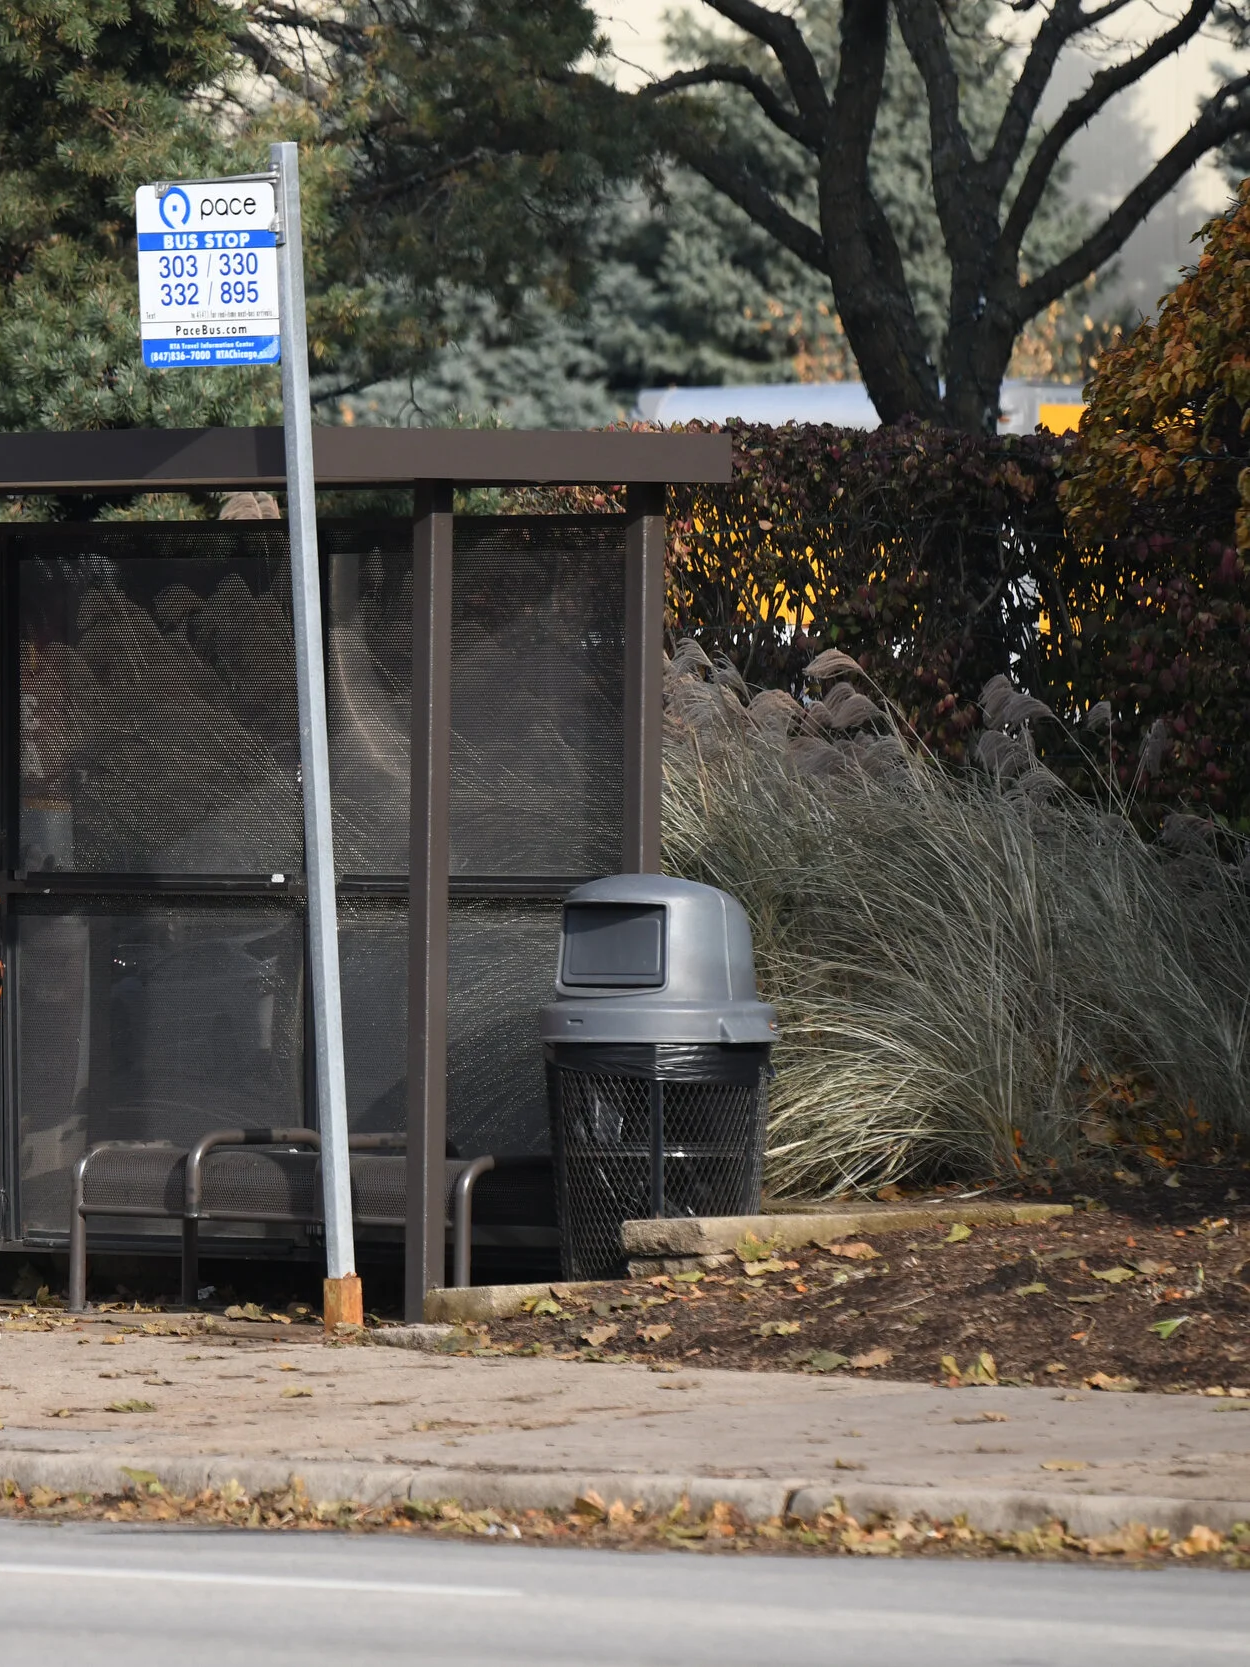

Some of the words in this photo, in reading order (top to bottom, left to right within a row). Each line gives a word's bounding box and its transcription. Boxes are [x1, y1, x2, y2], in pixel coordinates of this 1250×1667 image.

[200, 197, 257, 221] pace
[163, 234, 199, 250] BUS
[204, 232, 250, 248] STOP
[159, 255, 198, 278] 303
[219, 252, 258, 276] 330
[160, 282, 199, 306] 332
[220, 281, 259, 304] 895
[175, 325, 247, 336] PaceBus.com
[169, 342, 180, 350] RTA
[200, 341, 234, 349] Information
[235, 340, 255, 348] Center
[150, 350, 211, 363] (847)836-7000
